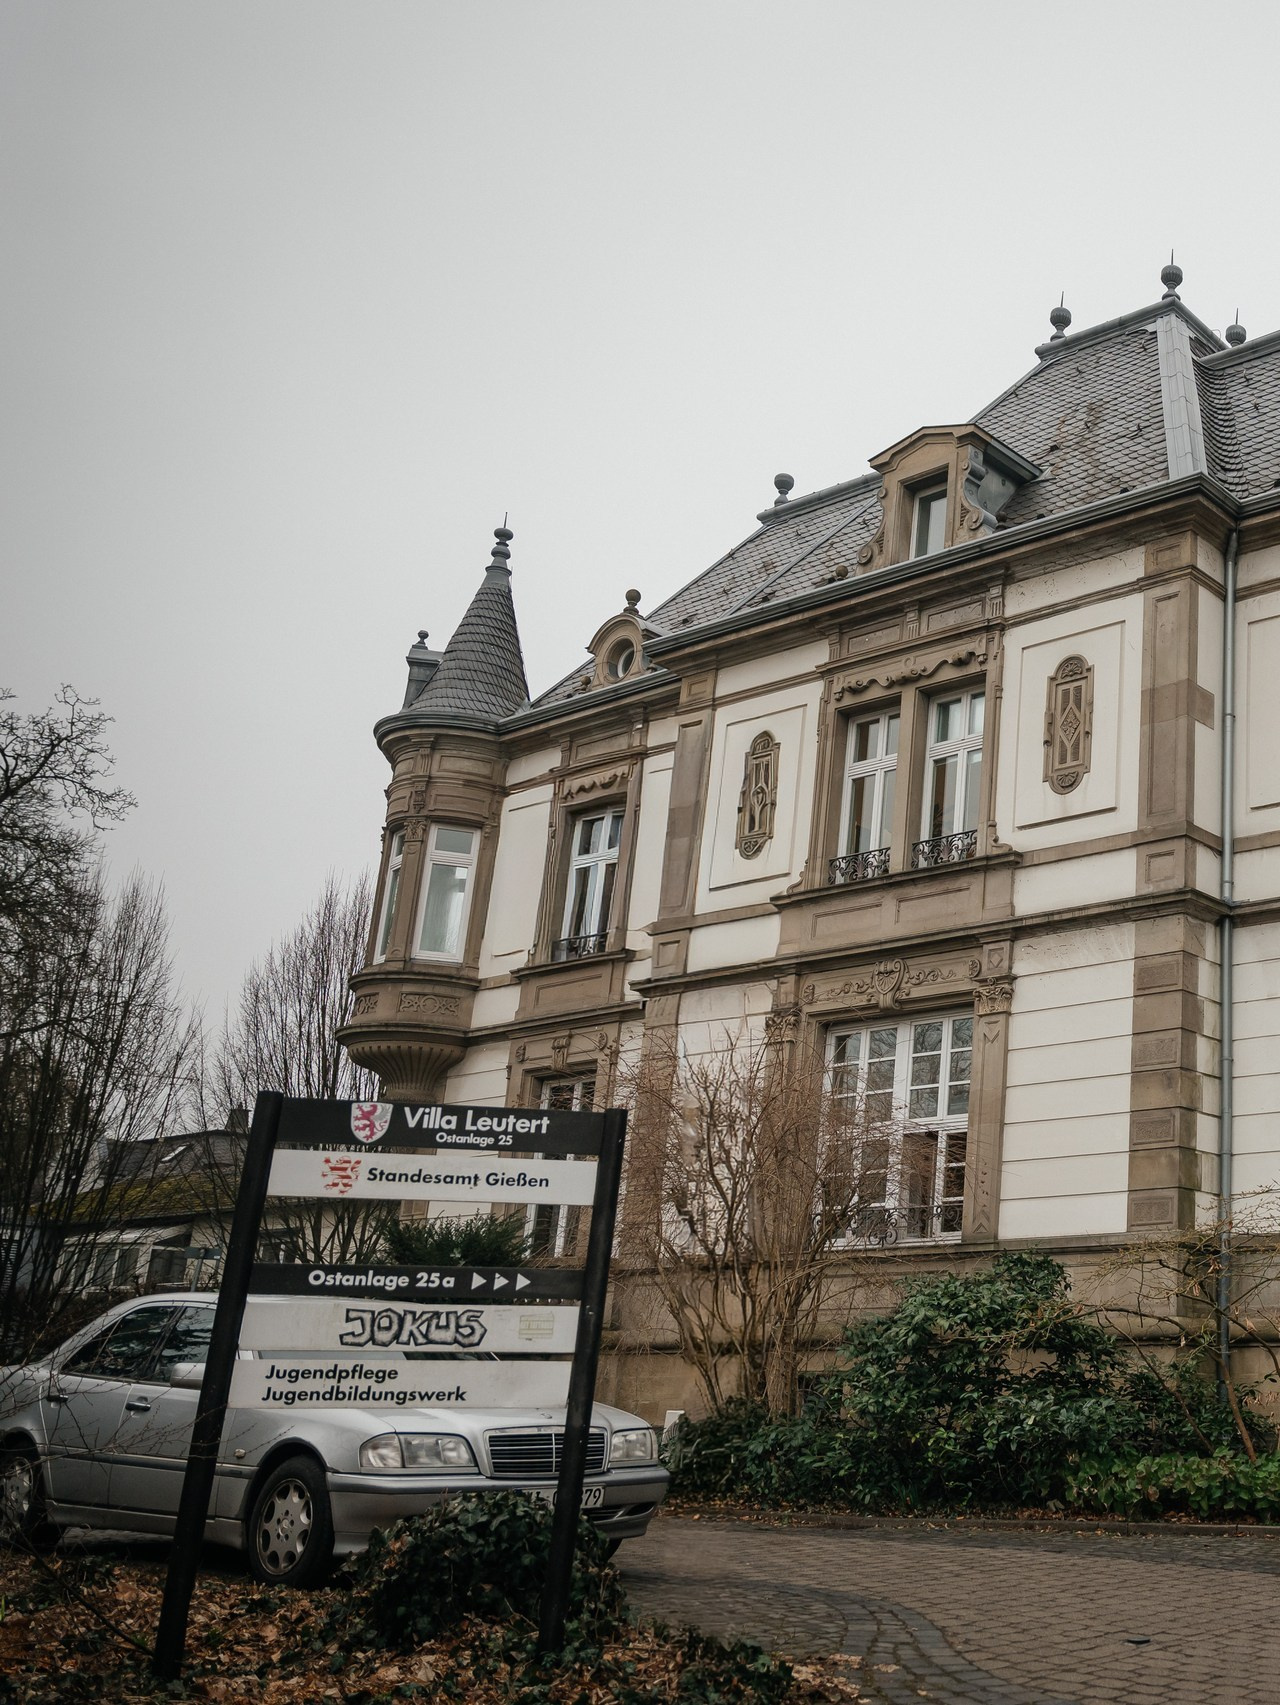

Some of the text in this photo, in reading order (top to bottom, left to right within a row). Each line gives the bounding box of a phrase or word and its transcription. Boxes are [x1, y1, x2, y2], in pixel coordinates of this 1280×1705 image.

[404, 1106, 550, 1134] Villa Leutert
[435, 1132, 513, 1147] Ostanlage 25
[366, 1167, 550, 1188] Standesamt Gießen
[308, 1269, 410, 1291] Ostanlage
[338, 1307, 488, 1348] JOKUS
[265, 1363, 399, 1384] Jugendpflege
[261, 1386, 467, 1406] Jugendbildungswerk
